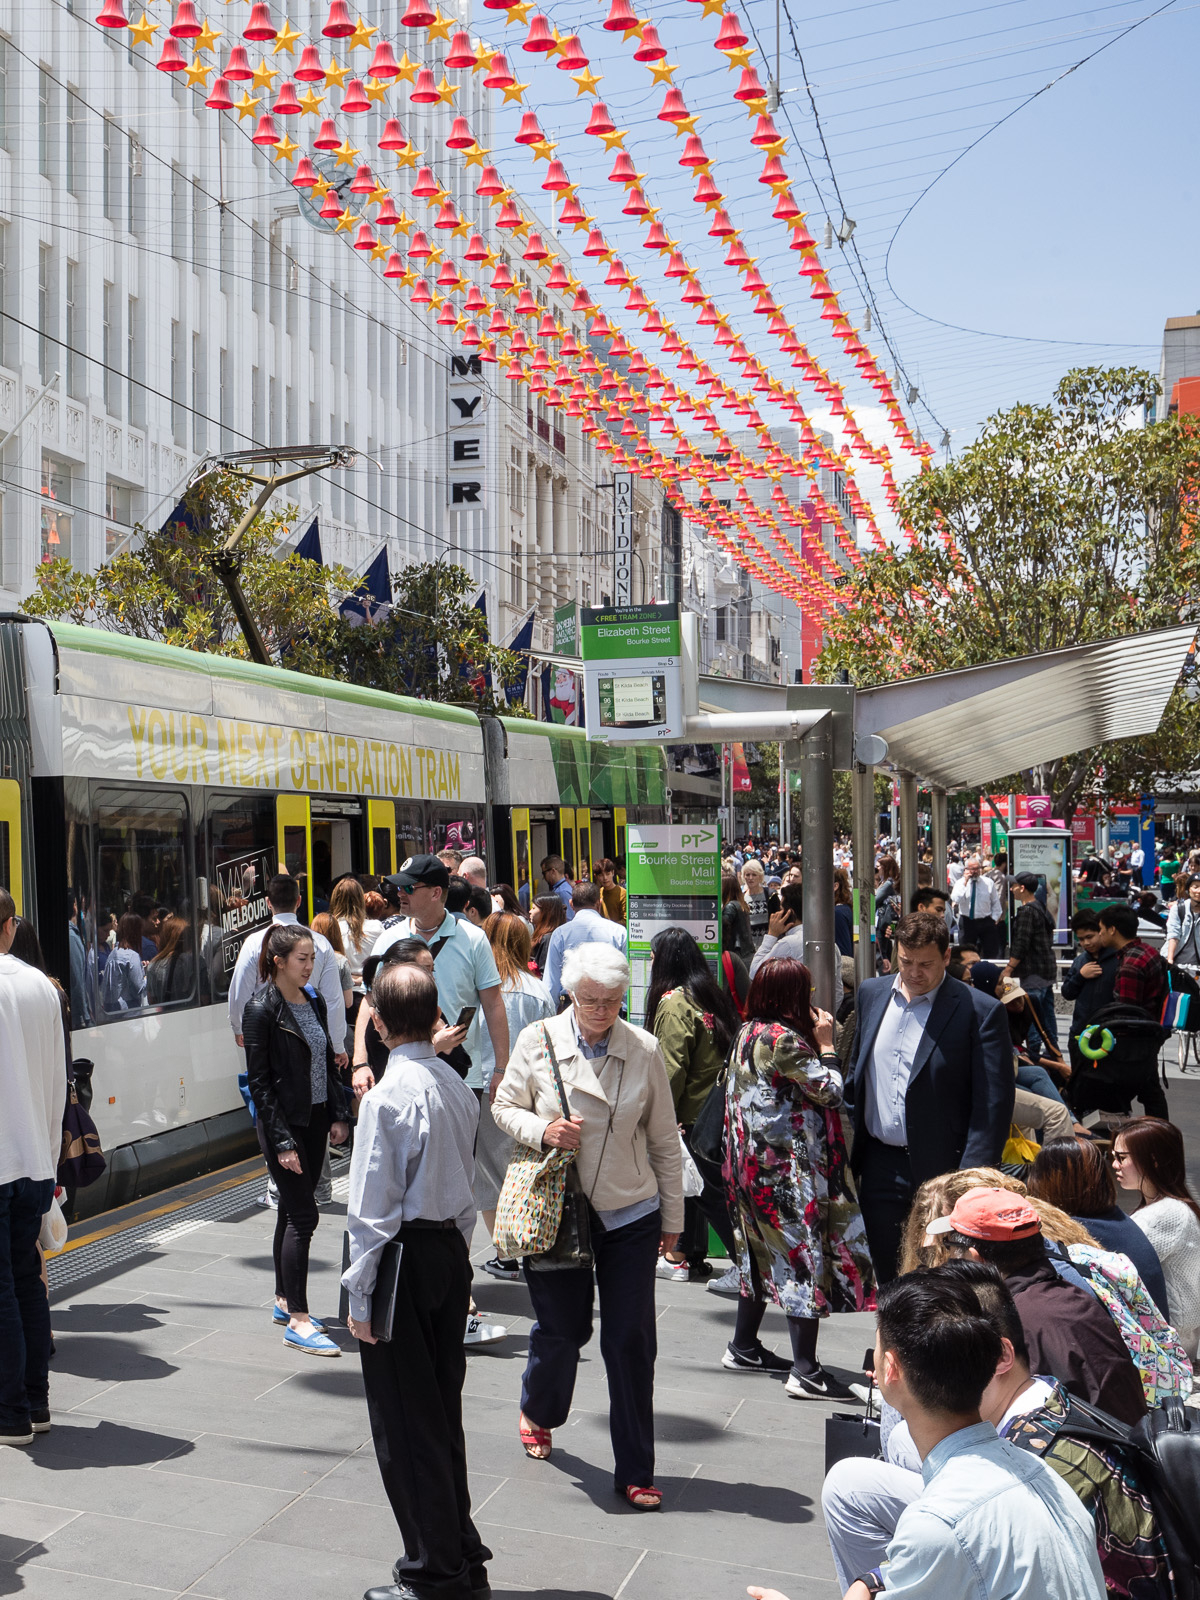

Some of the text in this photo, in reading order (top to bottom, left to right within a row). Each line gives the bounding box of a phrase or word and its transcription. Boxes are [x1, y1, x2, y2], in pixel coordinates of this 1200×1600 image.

[451, 353, 483, 504] MYER
[616, 482, 630, 606] DAVID JONE
[600, 614, 617, 622] FREE
[597, 625, 671, 638] Elizabeth Street
[667, 658, 674, 666] 5
[127, 706, 461, 800] YOUR NEXT GENERATION TRAM
[638, 854, 715, 865] Bourke Street
[691, 866, 715, 877] Mall
[218, 858, 262, 909] MADE
[704, 924, 716, 940] 5
[224, 941, 240, 965] FOR
